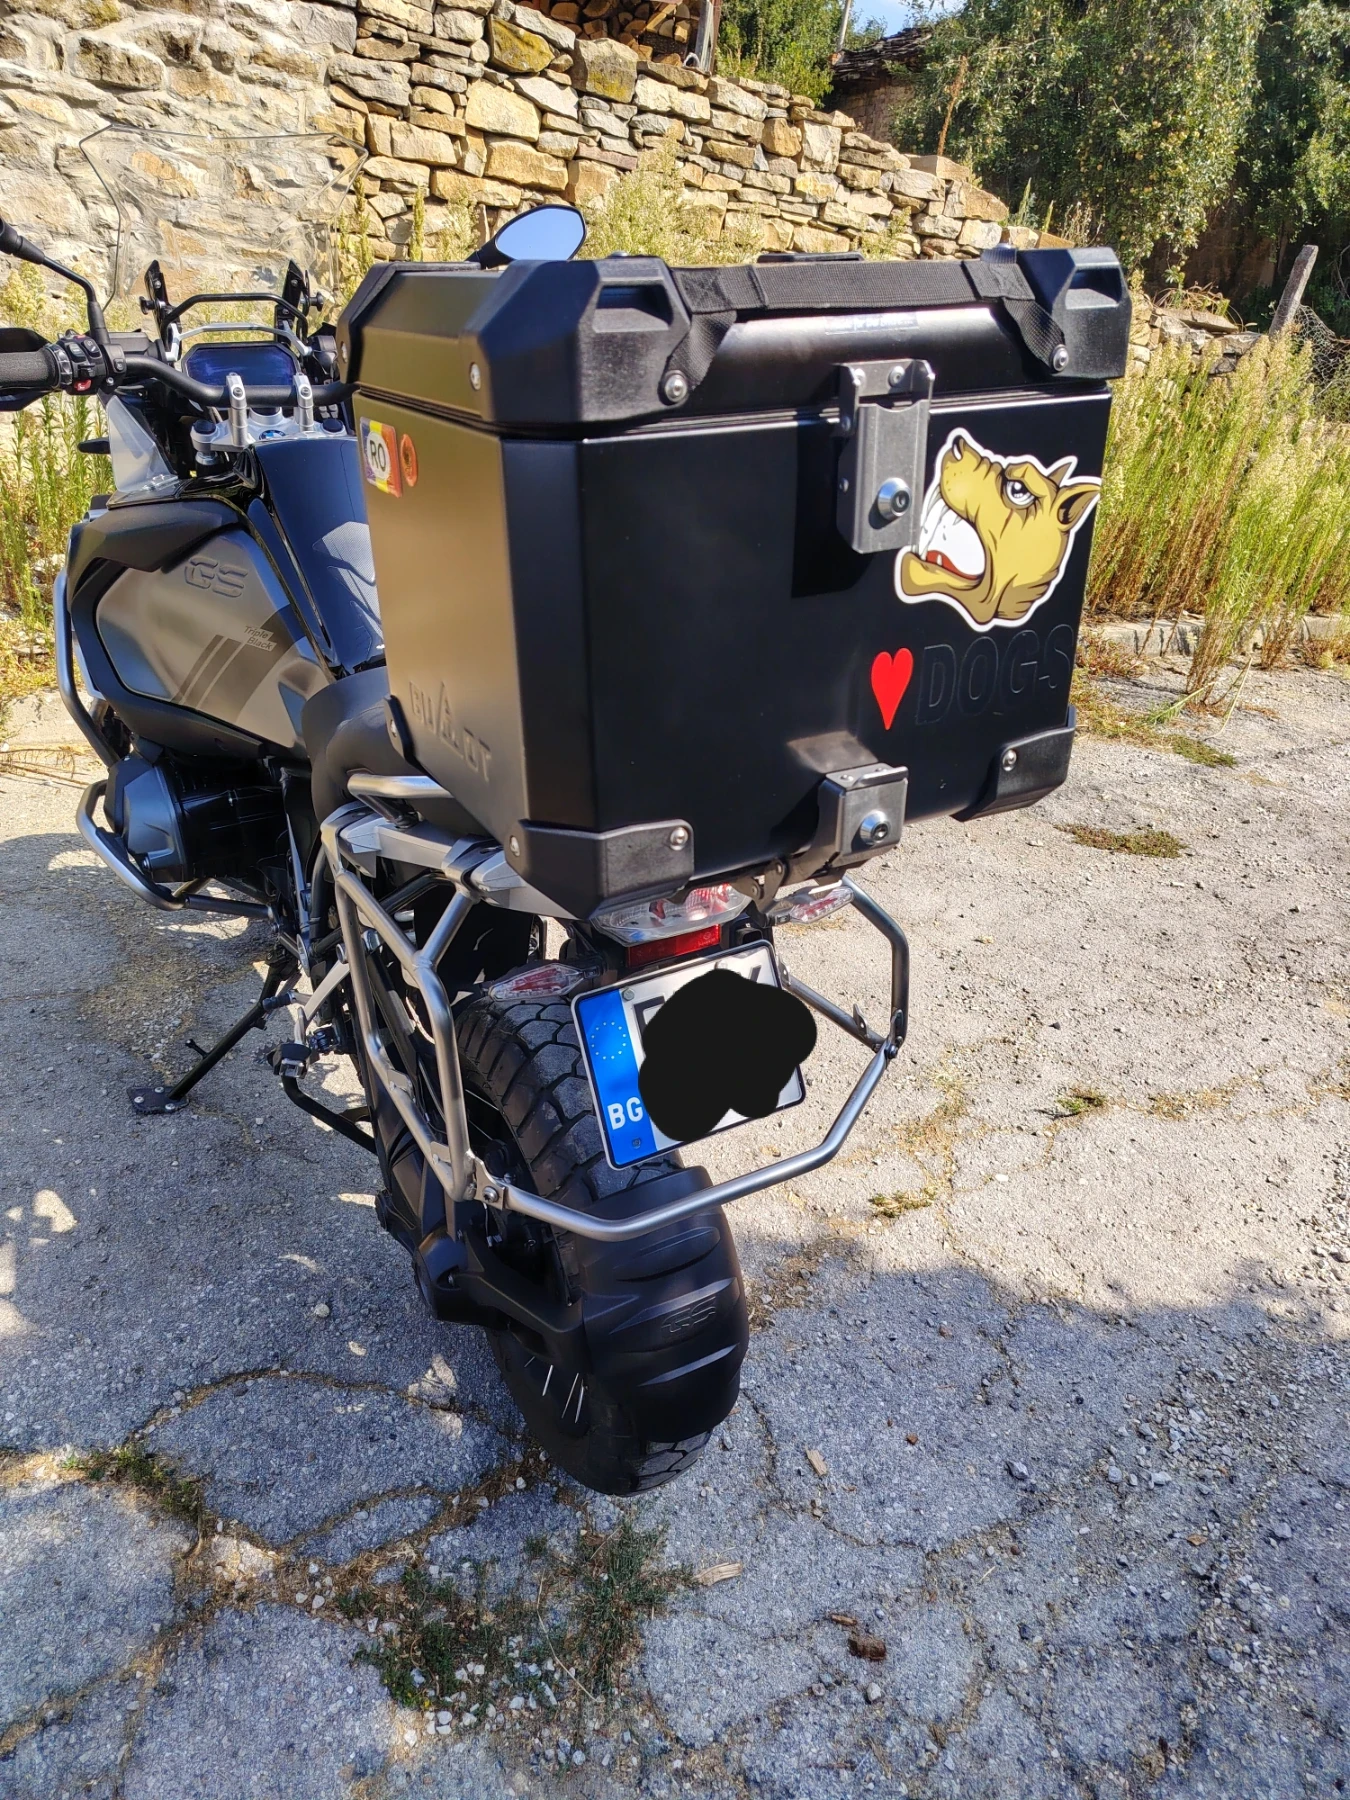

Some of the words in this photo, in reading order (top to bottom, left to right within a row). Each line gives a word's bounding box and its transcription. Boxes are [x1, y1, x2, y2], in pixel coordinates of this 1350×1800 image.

[369, 438, 387, 473] RO
[183, 555, 248, 599] GS
[243, 624, 269, 640] Triple
[246, 635, 273, 651] Black
[915, 623, 1075, 726] DOGS
[607, 1096, 645, 1131] BG
[660, 1294, 717, 1335] GS
